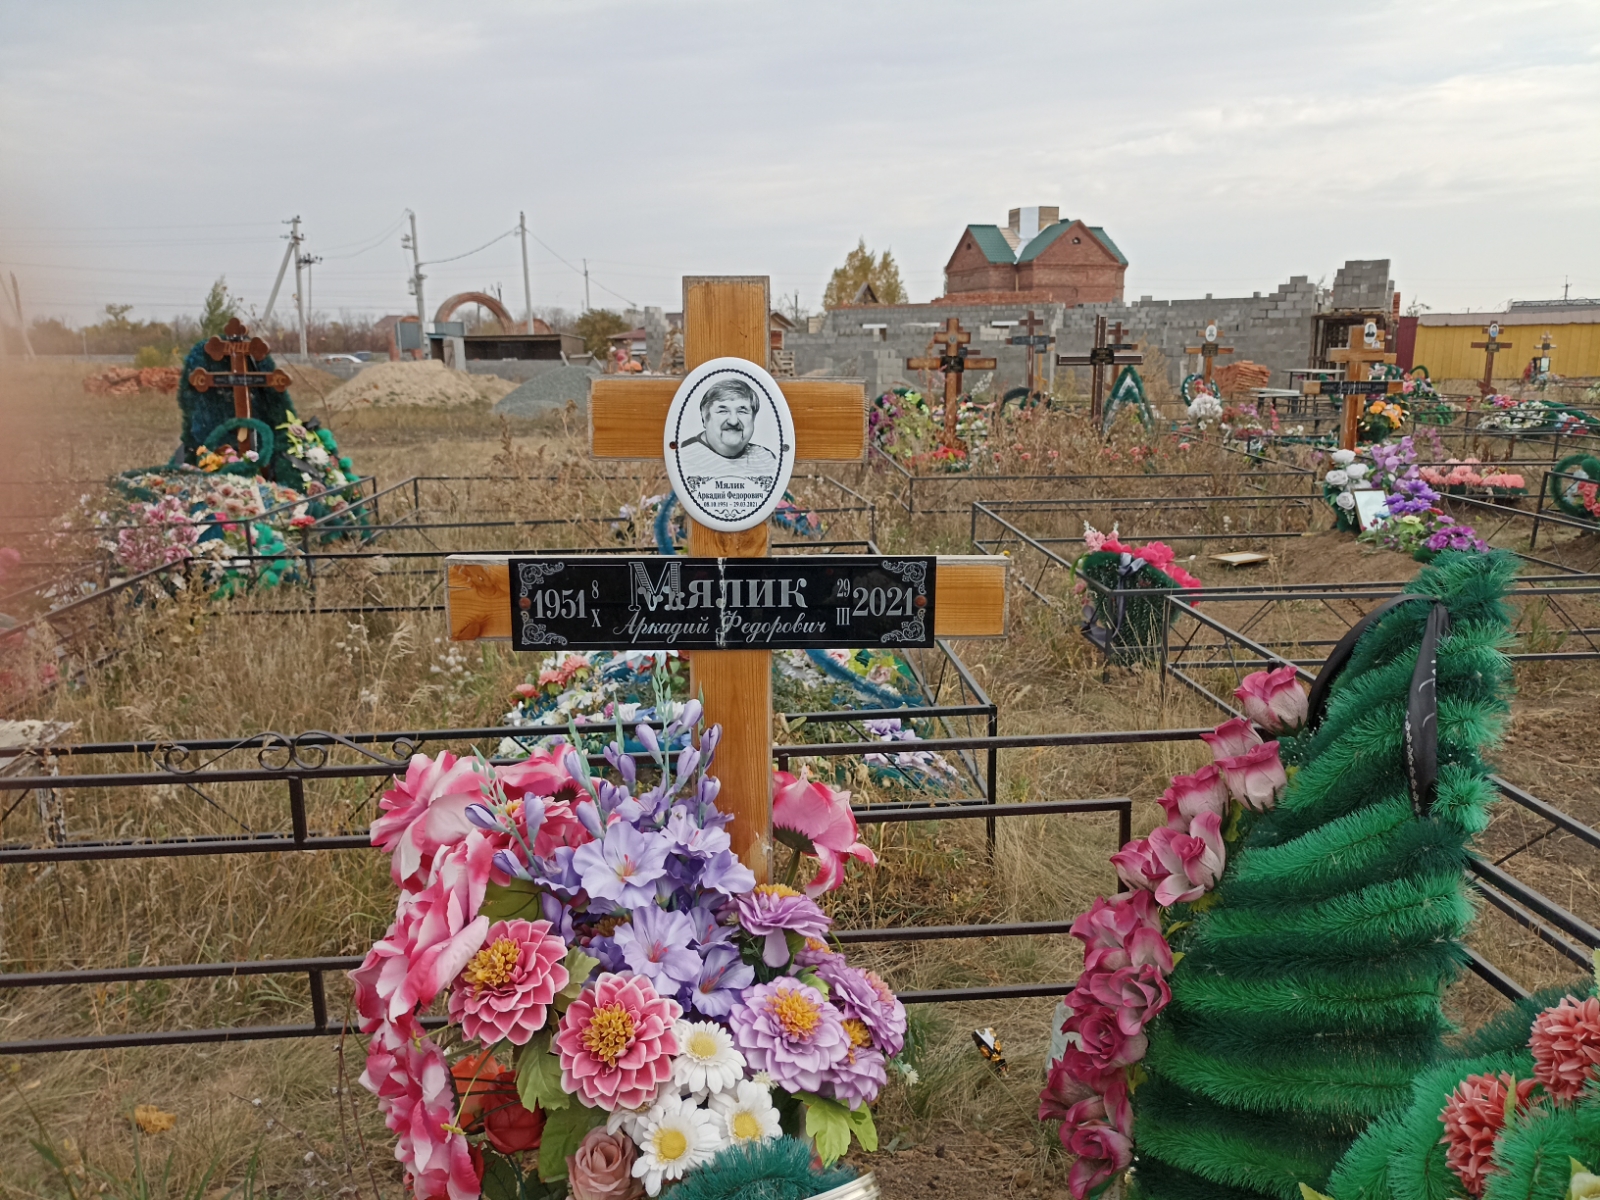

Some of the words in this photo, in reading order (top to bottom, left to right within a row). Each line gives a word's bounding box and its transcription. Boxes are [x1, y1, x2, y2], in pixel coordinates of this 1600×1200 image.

[715, 480, 745, 490] Мялик
[697, 491, 726, 501] Аркадий
[726, 491, 764, 501] Федорович
[591, 579, 599, 599] 8
[836, 578, 850, 598] 29
[533, 588, 588, 619] 1951
[852, 586, 914, 617] 2021
[613, 610, 710, 644] Аркадий
[715, 609, 827, 643] Федорович
